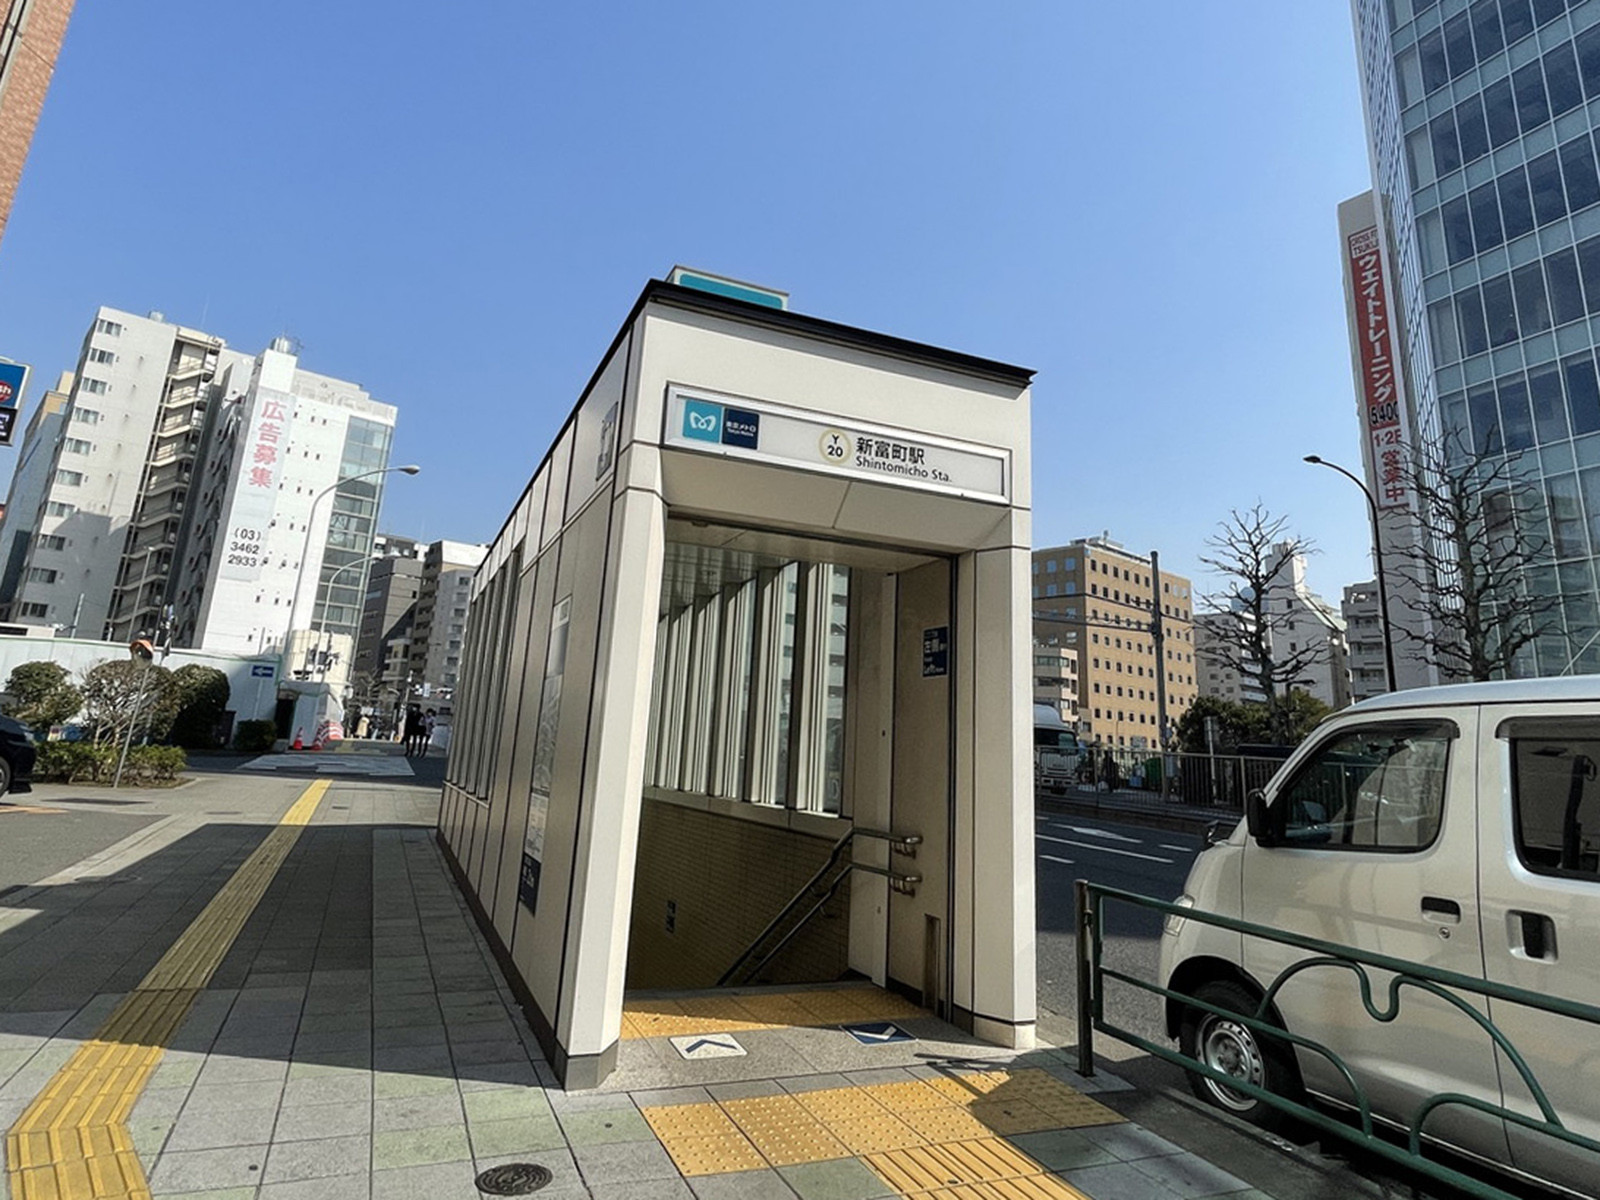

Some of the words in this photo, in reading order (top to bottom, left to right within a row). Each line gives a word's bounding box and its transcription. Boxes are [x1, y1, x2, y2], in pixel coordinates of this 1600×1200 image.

[1358, 253, 1392, 402] ウエイトトレーニング
[249, 402, 286, 488] 広告募集
[831, 434, 840, 445] Y
[827, 444, 844, 458] 20
[856, 437, 926, 466] 新富町駅
[855, 455, 929, 479] Shintomicho
[931, 468, 953, 483] Sta.
[1381, 448, 1405, 502] 営業中
[234, 528, 262, 541] (03)
[230, 541, 260, 555] 3462
[227, 554, 257, 568] 2933
